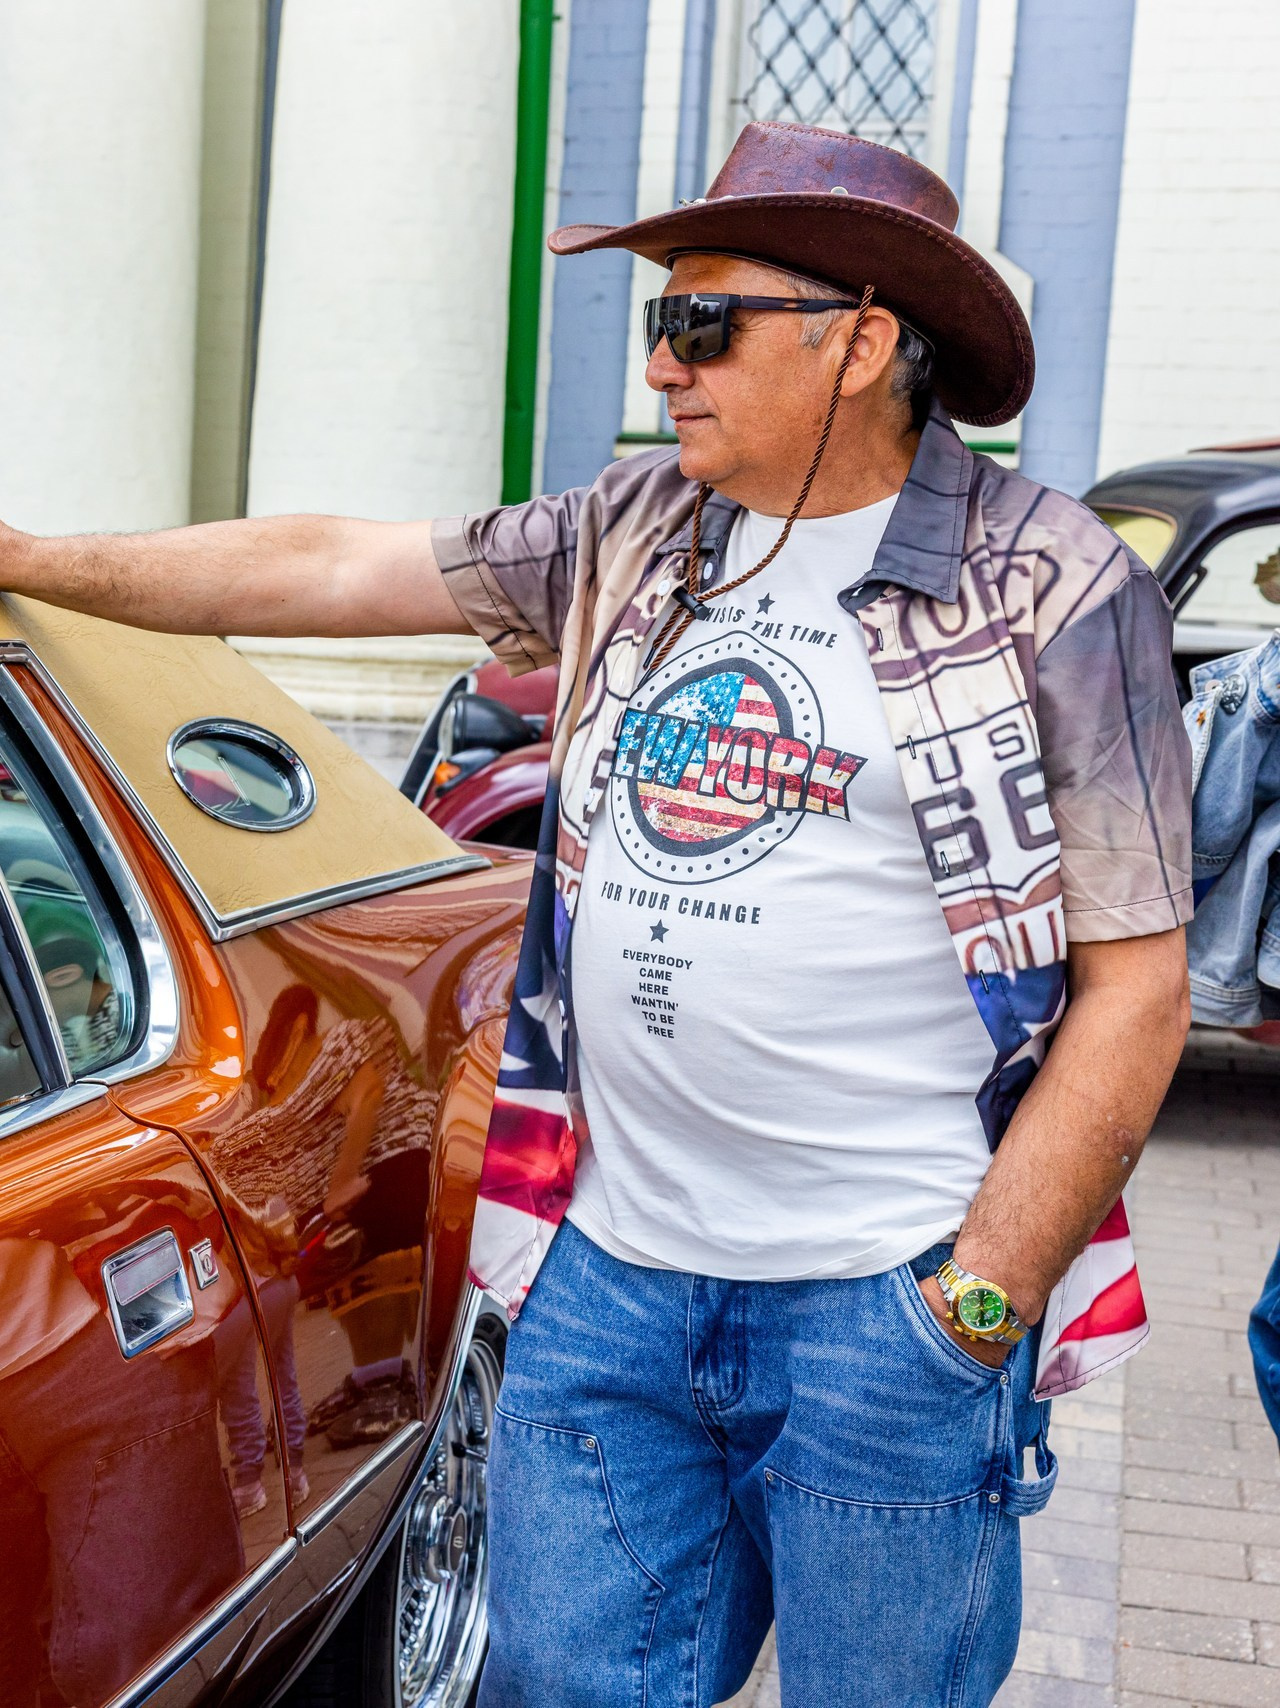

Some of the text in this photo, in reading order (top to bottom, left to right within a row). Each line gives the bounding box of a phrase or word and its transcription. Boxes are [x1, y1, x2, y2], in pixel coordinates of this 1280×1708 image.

[703, 606, 727, 623] HIS
[750, 620, 784, 639] THE
[789, 625, 838, 648] TIME
[610, 707, 869, 822] EW YORK
[600, 881, 622, 902] FOR
[628, 887, 670, 911] YOUR
[677, 897, 762, 925] CHANGE
[622, 949, 693, 970] EVERYBODY
[639, 967, 673, 981] CAME
[638, 982, 669, 996] HERE
[631, 995, 679, 1012] WANTIN'
[642, 1011, 675, 1025] TO BE
[647, 1025, 675, 1039] FREE
